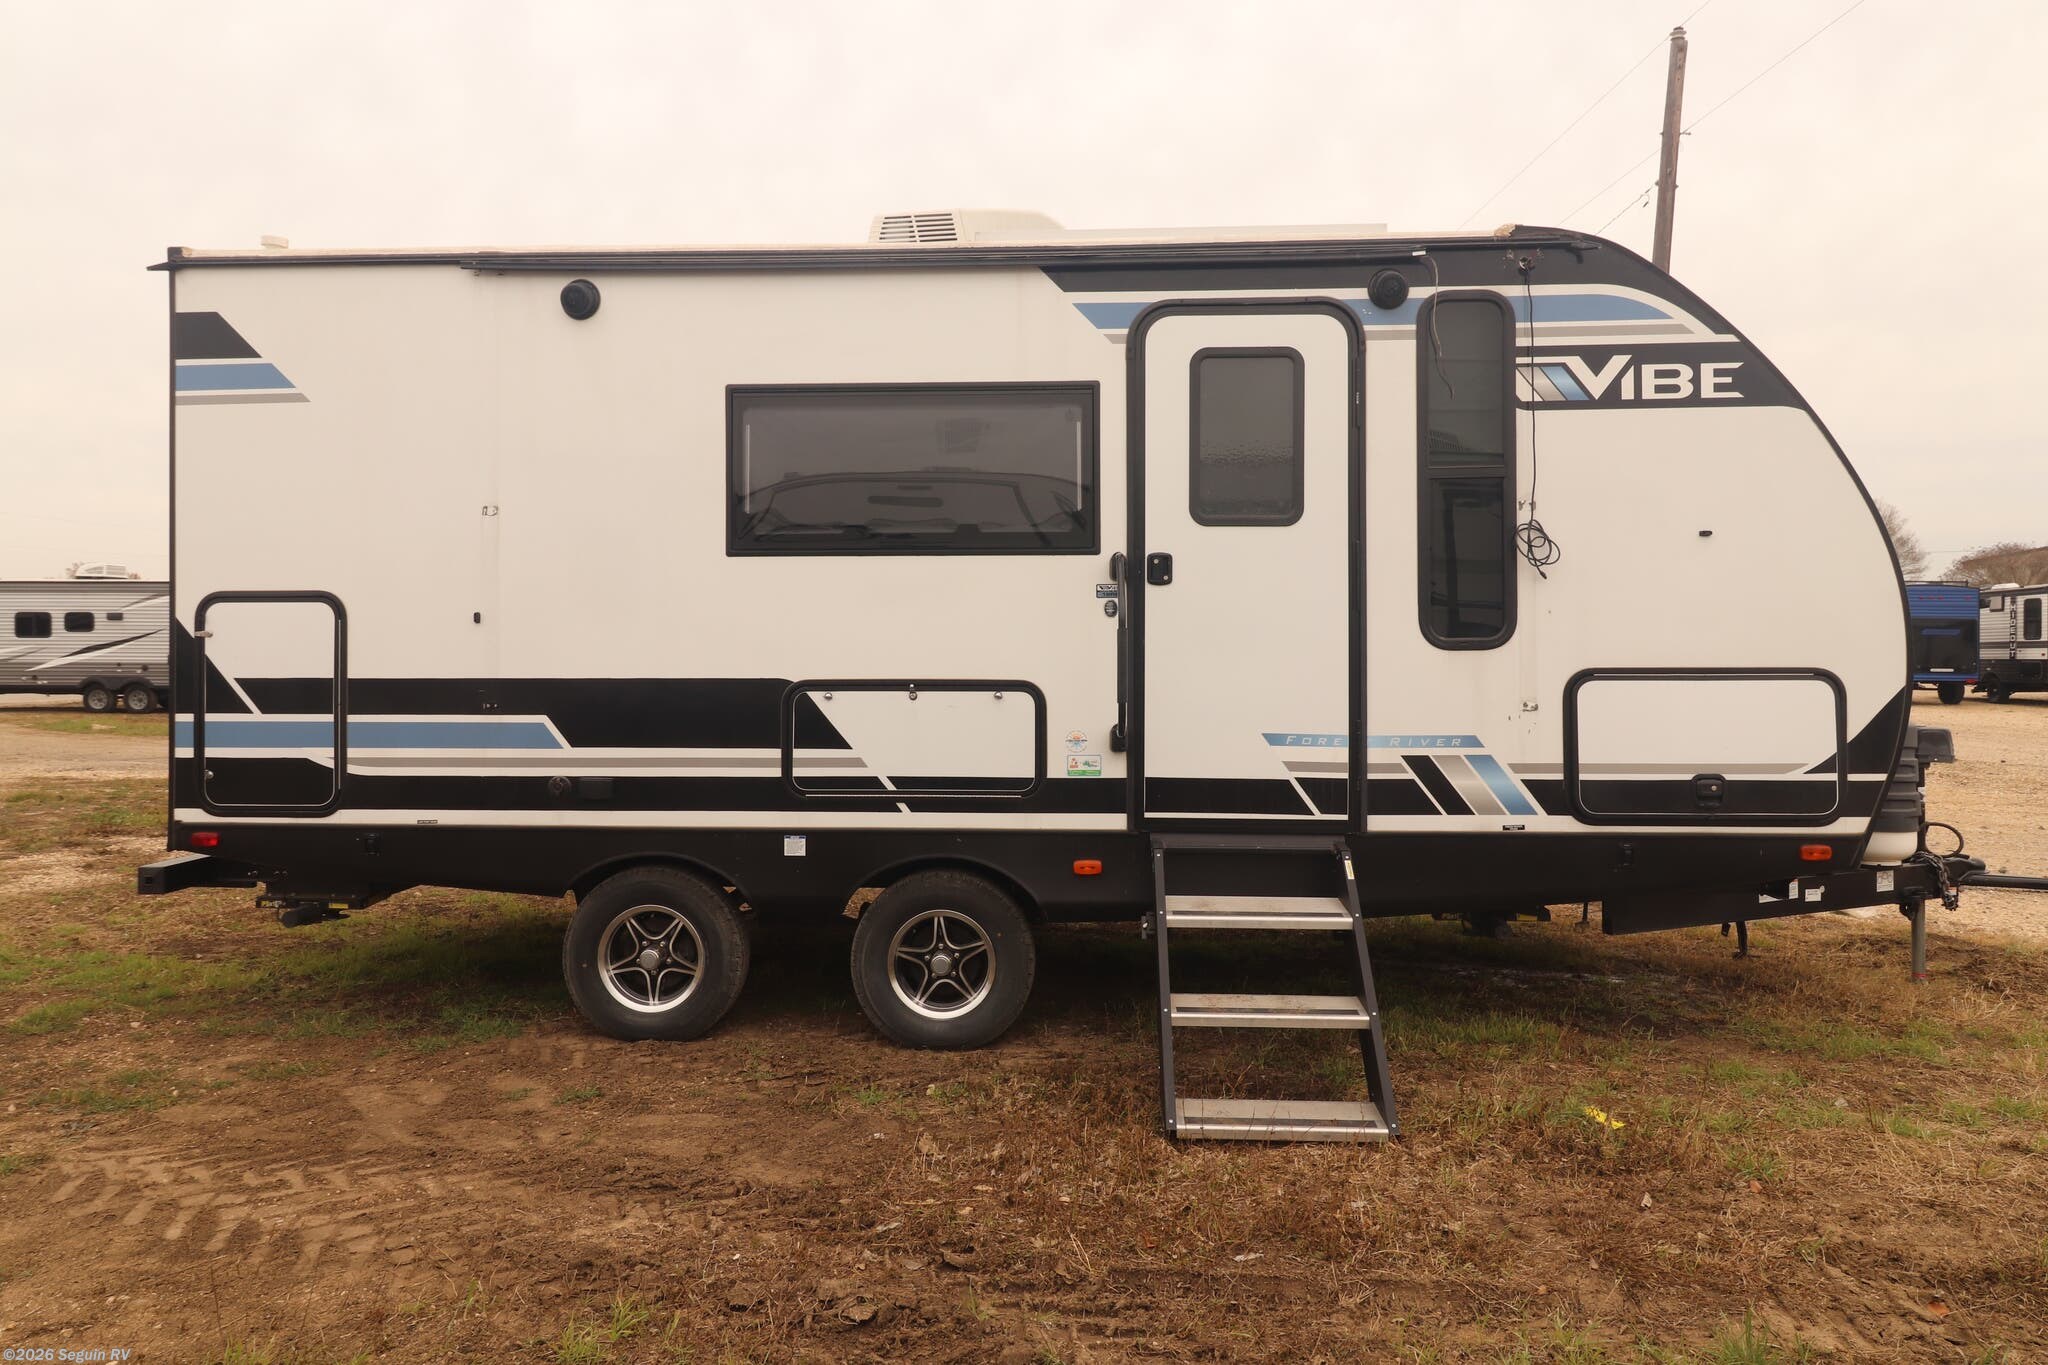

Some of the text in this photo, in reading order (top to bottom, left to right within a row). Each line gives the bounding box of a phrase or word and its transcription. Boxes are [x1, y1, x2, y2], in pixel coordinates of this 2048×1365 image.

[1568, 354, 1745, 401] VIBE
[1286, 735, 1462, 747] FORE RIVER
